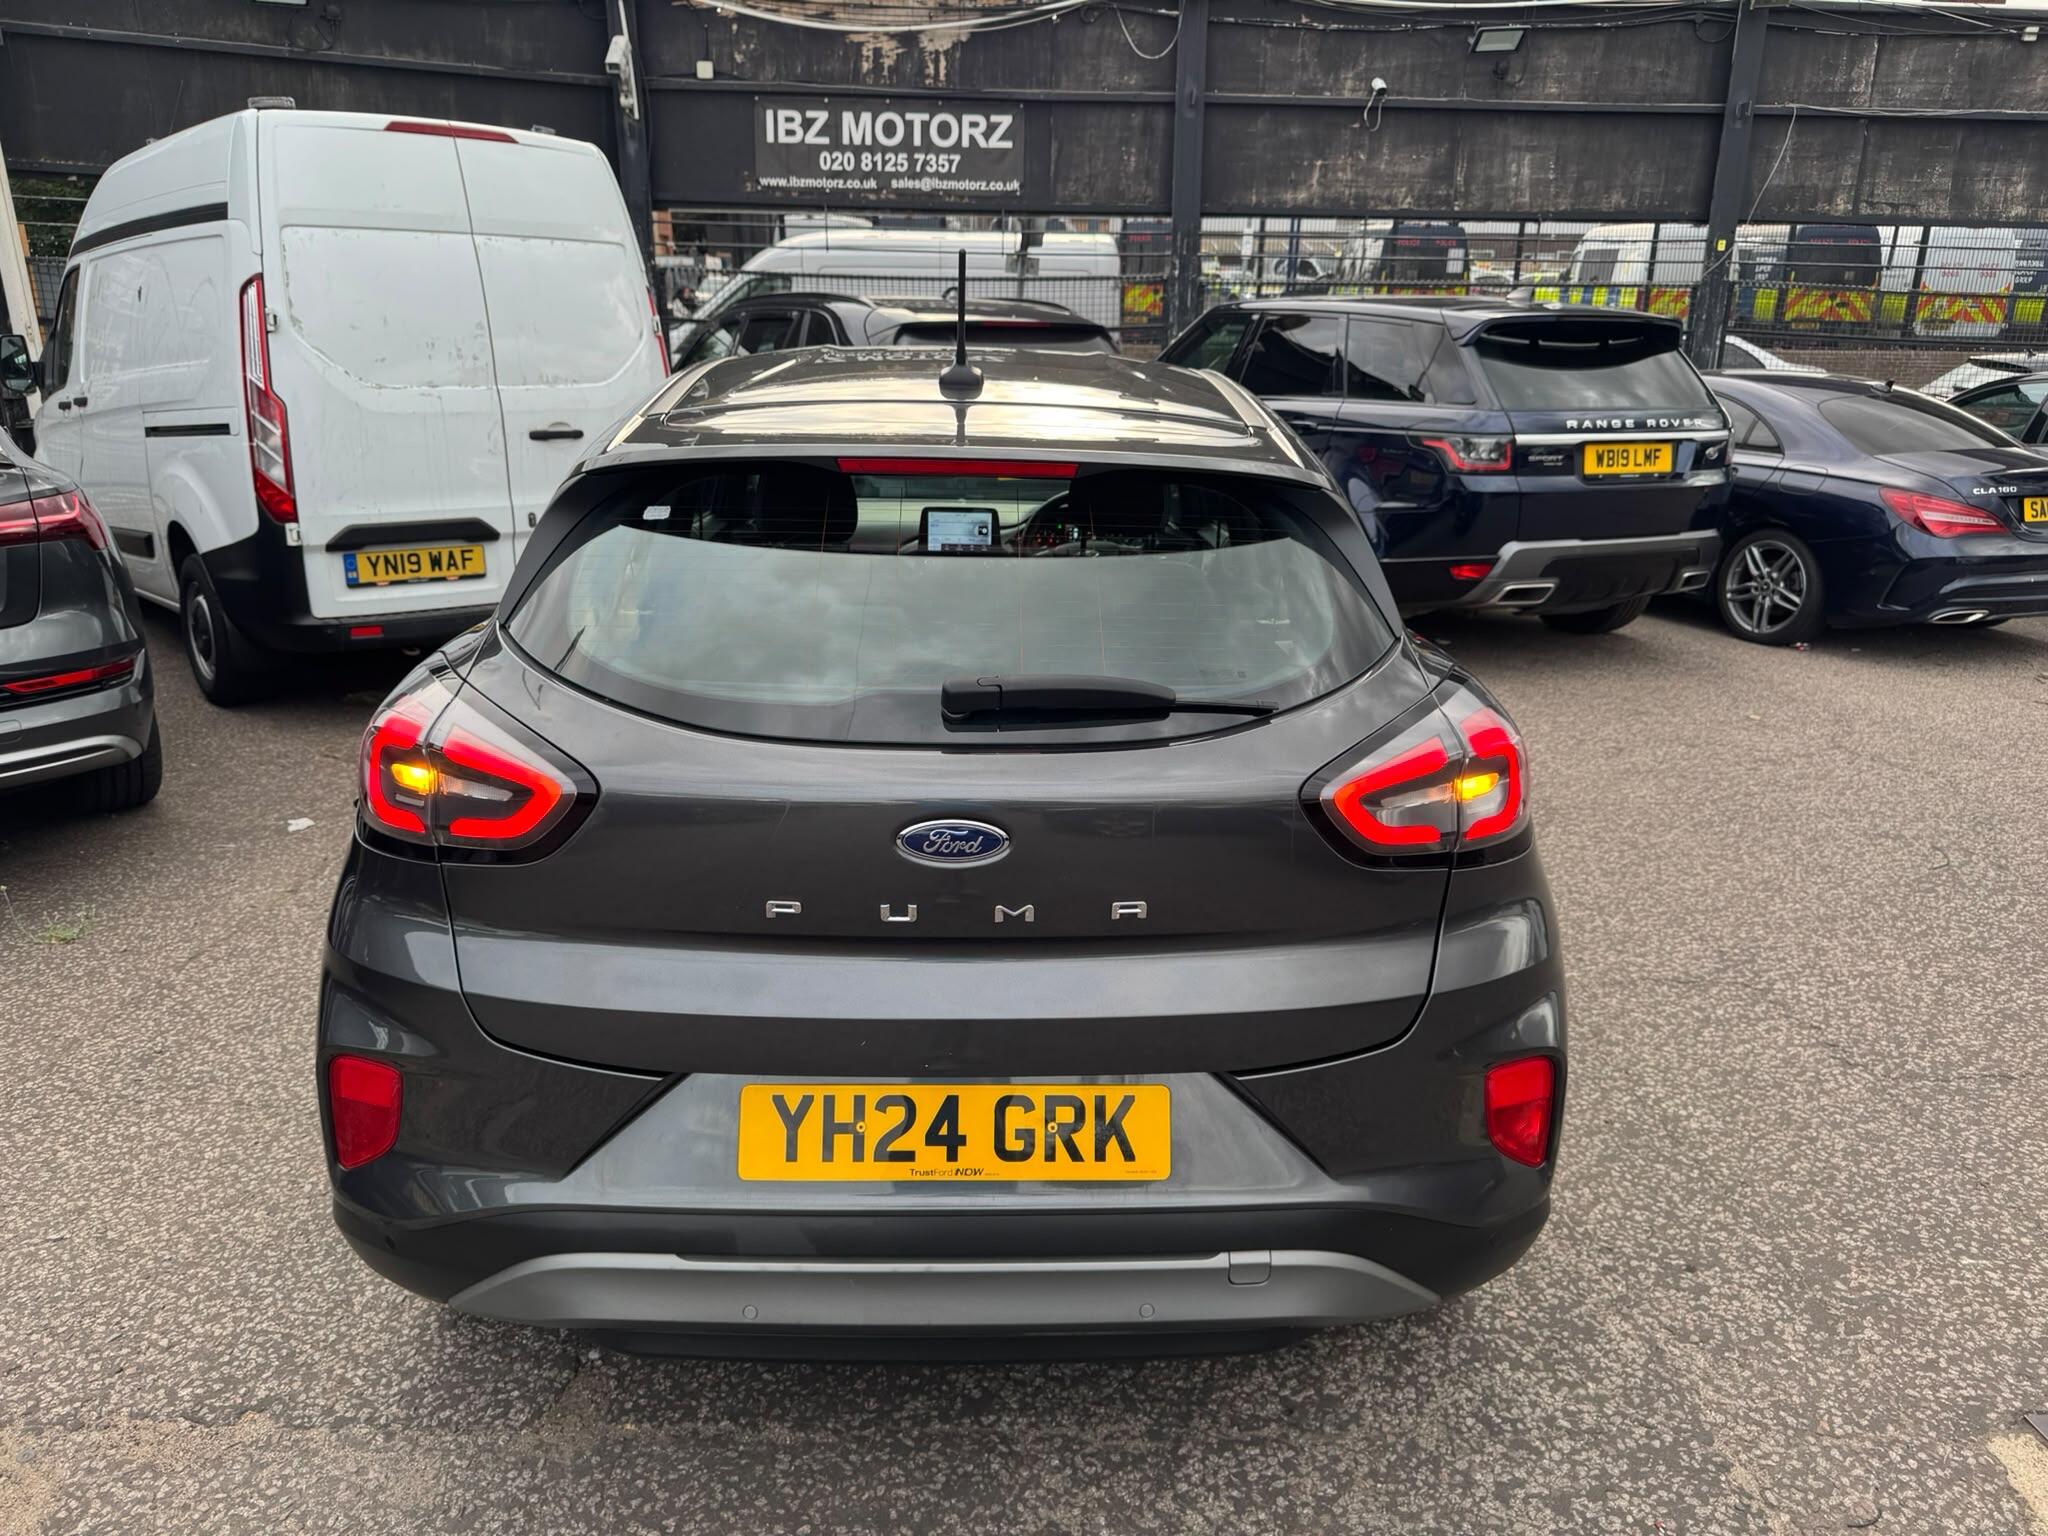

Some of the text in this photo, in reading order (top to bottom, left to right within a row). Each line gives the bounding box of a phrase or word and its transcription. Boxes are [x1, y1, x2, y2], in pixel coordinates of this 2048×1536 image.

[765, 109, 1014, 149] IBZ MOTORZ
[819, 151, 961, 174] 020 8125 7357
[759, 175, 1021, 192] www.ibzmotorz.co.uk sales@ibzmotorz.co.uk
[1566, 417, 1704, 430] RANGE ROVER
[1595, 448, 1662, 469] WB19 LMF
[1972, 487, 1997, 495] CLA
[2030, 499, 2048, 519] SA
[366, 548, 474, 577] YN19 WAF
[922, 828, 984, 855] Ford
[765, 900, 1148, 923] PUMA
[771, 1094, 1137, 1163] YH24 GRK
[909, 1168, 953, 1177] TrustFord
